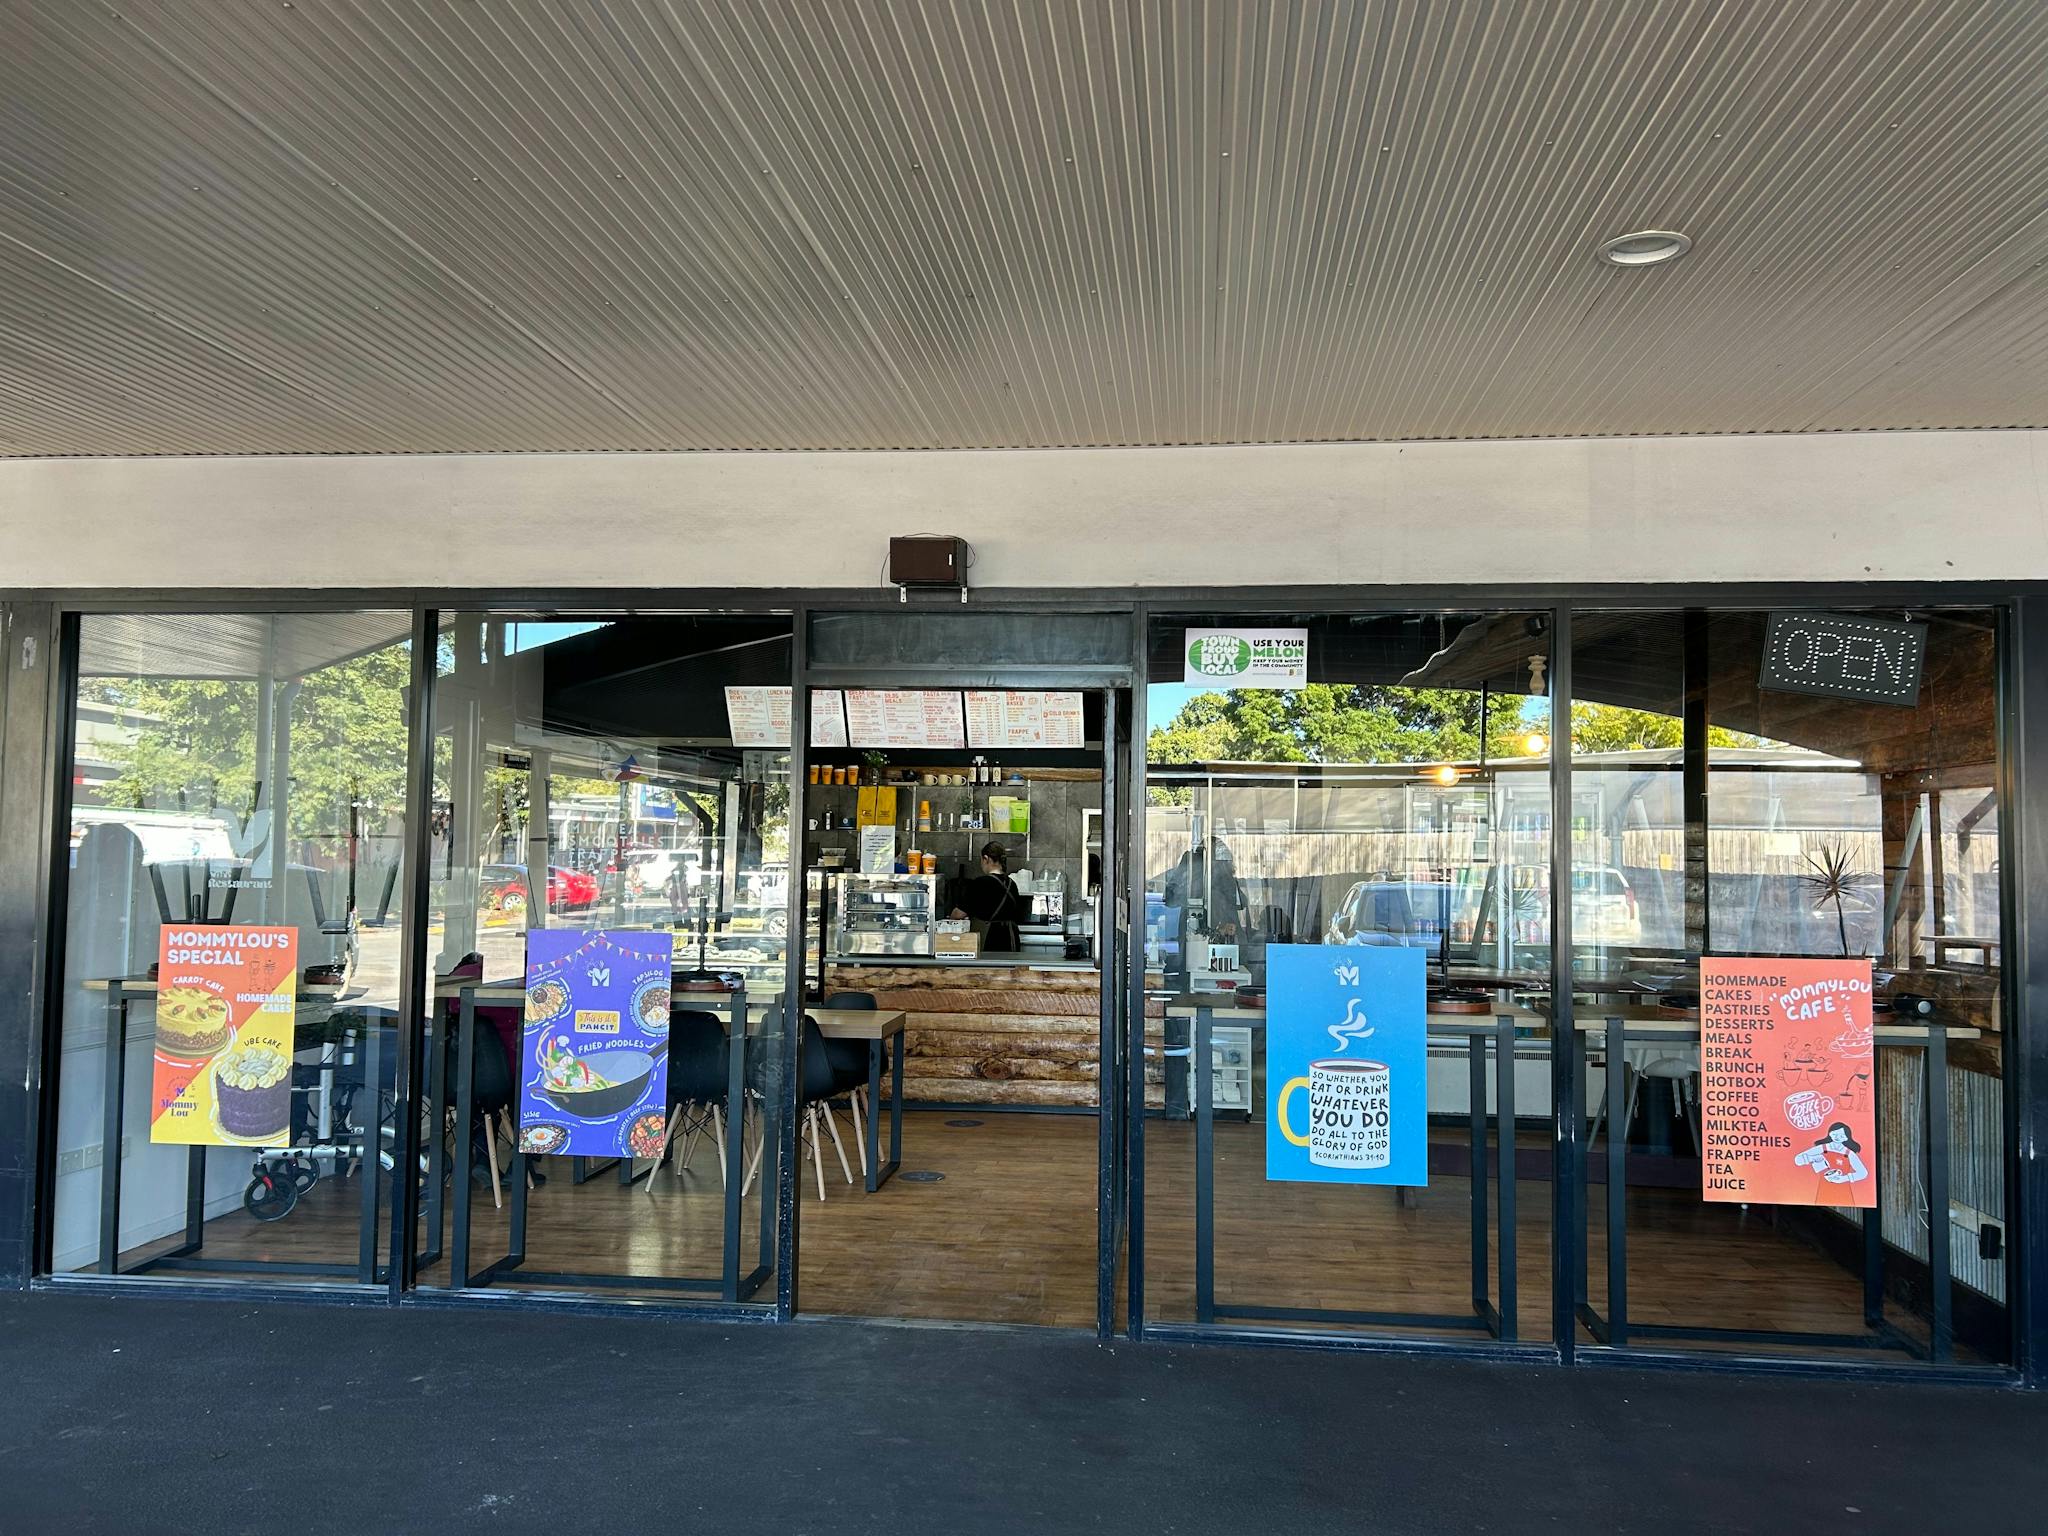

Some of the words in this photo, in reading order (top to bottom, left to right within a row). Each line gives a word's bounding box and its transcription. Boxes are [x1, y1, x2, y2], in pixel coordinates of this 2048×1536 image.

[1201, 635, 1240, 647] TOWN
[1253, 639, 1272, 647] USE
[1275, 639, 1304, 647] YOUR
[1201, 646, 1240, 654] PROUD
[1253, 647, 1304, 658] MELON
[1201, 653, 1239, 665] BUY
[1784, 630, 1904, 684] OPEN
[1201, 664, 1239, 675] LOCAL
[168, 931, 290, 949] MOMMYLOU'S
[167, 949, 245, 966] SPECIAL
[632, 970, 663, 985] TAPSILOG
[1705, 975, 1787, 987] HOMEMADE
[172, 976, 205, 985] CARROT
[205, 979, 225, 993] CAKE
[236, 993, 293, 1004] HOMEMADE
[1705, 989, 1752, 1000] CAKES
[260, 1003, 293, 1013] CAKES
[1705, 1004, 1770, 1016] PASTRIES
[1705, 1019, 1774, 1030] DESSERTS
[244, 1036, 260, 1047] UBE
[262, 1037, 282, 1049] CAKE
[1705, 1033, 1752, 1044] MEALS
[578, 1041, 603, 1054] FRIED
[605, 1039, 645, 1049] NOODLES
[1706, 1048, 1752, 1059] BREAK
[1706, 1062, 1764, 1074] BRUNCH
[1312, 1071, 1324, 1079] SO
[1326, 1074, 1367, 1084] WHETHER
[1370, 1074, 1387, 1082] YOU
[1706, 1076, 1766, 1088] HOTBOX
[1311, 1081, 1332, 1092] EAT
[1336, 1085, 1351, 1095] OR
[1356, 1083, 1388, 1095] DRINK
[1311, 1093, 1388, 1111] WHATEVER
[1706, 1091, 1759, 1103] COFFEE
[161, 1099, 198, 1111] Mommy
[1706, 1105, 1760, 1117] CHOCO
[171, 1108, 188, 1117] Lou
[1312, 1108, 1353, 1128] YOU
[1362, 1111, 1389, 1128] DO
[1707, 1120, 1768, 1132] MILKTEA
[1312, 1126, 1325, 1136] DO
[1329, 1130, 1347, 1139] ALL
[1352, 1131, 1365, 1140] TO
[1368, 1128, 1388, 1139] THE
[1312, 1137, 1346, 1151] GLORY
[1350, 1143, 1363, 1151] OF
[1367, 1140, 1388, 1150] GOD
[1707, 1135, 1791, 1148] SMOOTHIES
[1707, 1149, 1760, 1161] FRAPPE
[1707, 1164, 1733, 1175] TEA
[1707, 1178, 1745, 1190] JUICE
